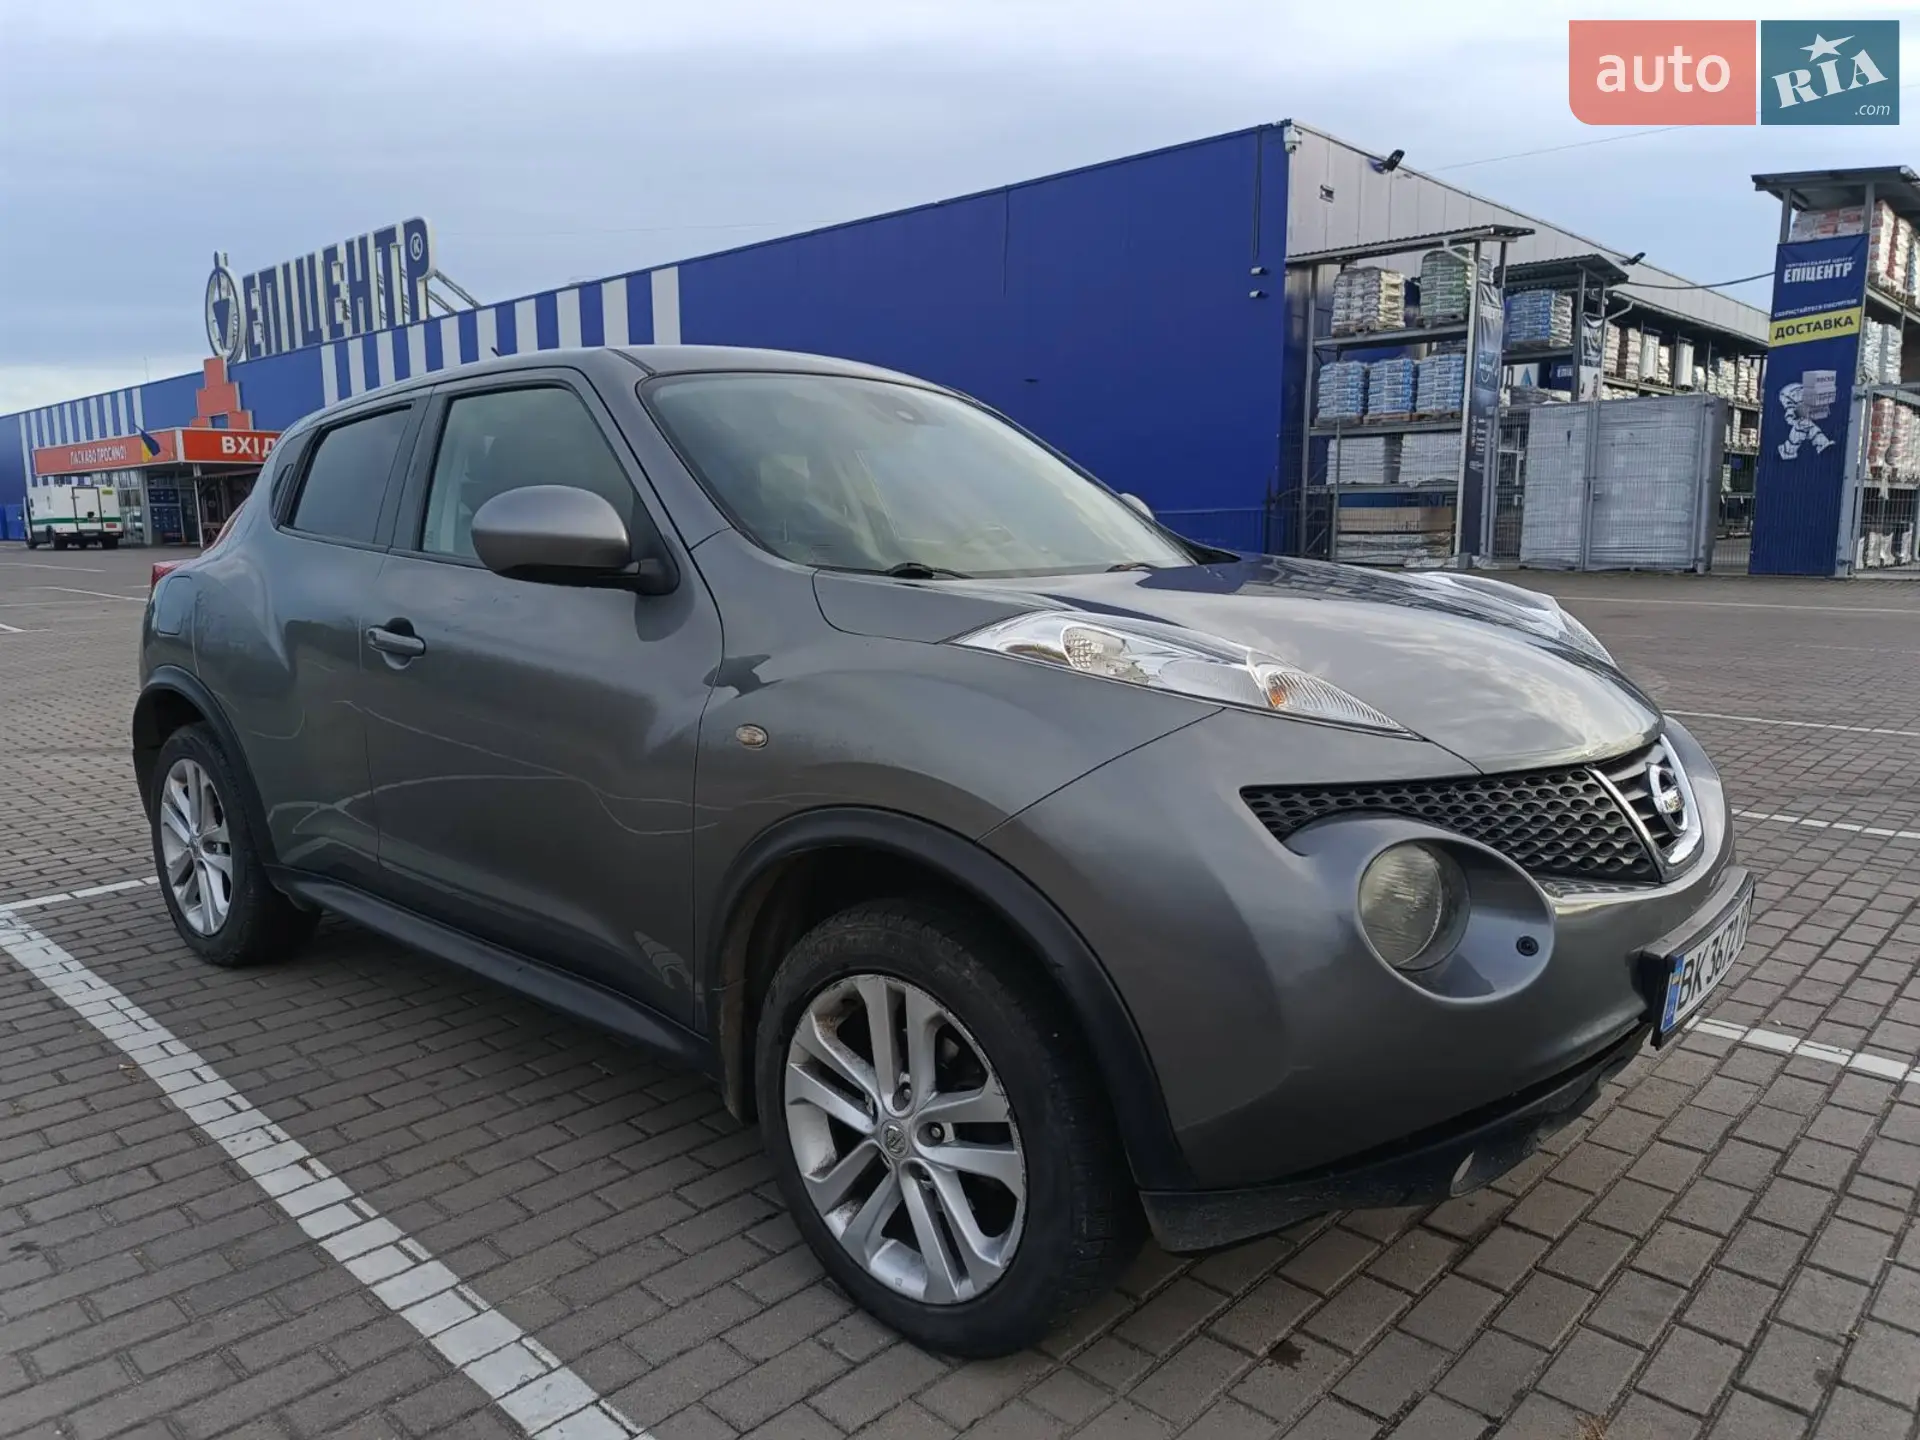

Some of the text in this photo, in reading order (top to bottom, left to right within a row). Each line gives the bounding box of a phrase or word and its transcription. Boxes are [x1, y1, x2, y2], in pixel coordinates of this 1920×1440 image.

[1783, 262, 1853, 283] ЕПІЦЕНТР
[242, 217, 432, 358] ЕПІЦЕНТР
[1774, 316, 1854, 340] ДОСТАВКА
